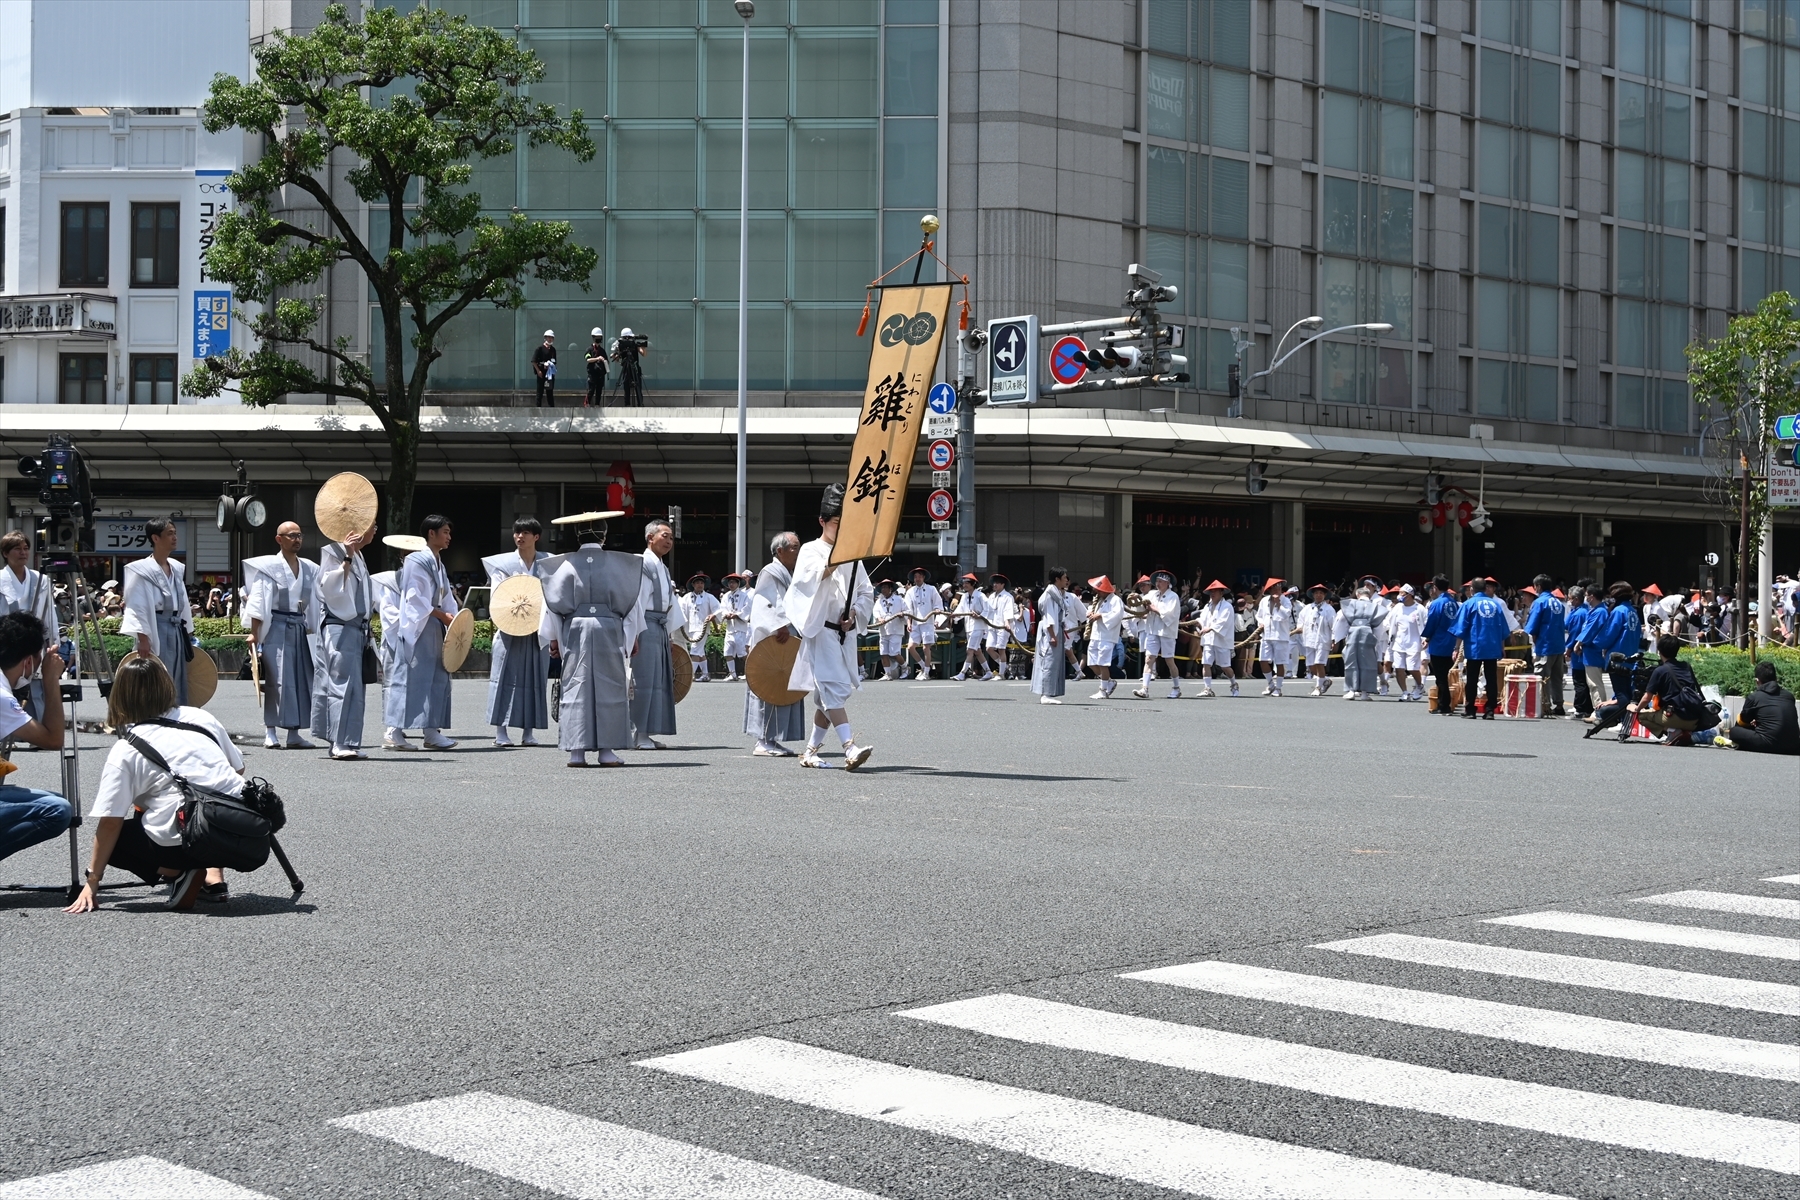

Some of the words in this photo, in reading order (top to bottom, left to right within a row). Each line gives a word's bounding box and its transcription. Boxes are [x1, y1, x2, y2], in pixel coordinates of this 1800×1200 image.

[197, 297, 211, 357] 買えます
[213, 298, 226, 329] すぐ
[900, 372, 922, 434] にわとり
[886, 463, 902, 500] ほこ
[1771, 468, 1792, 477] Don't
